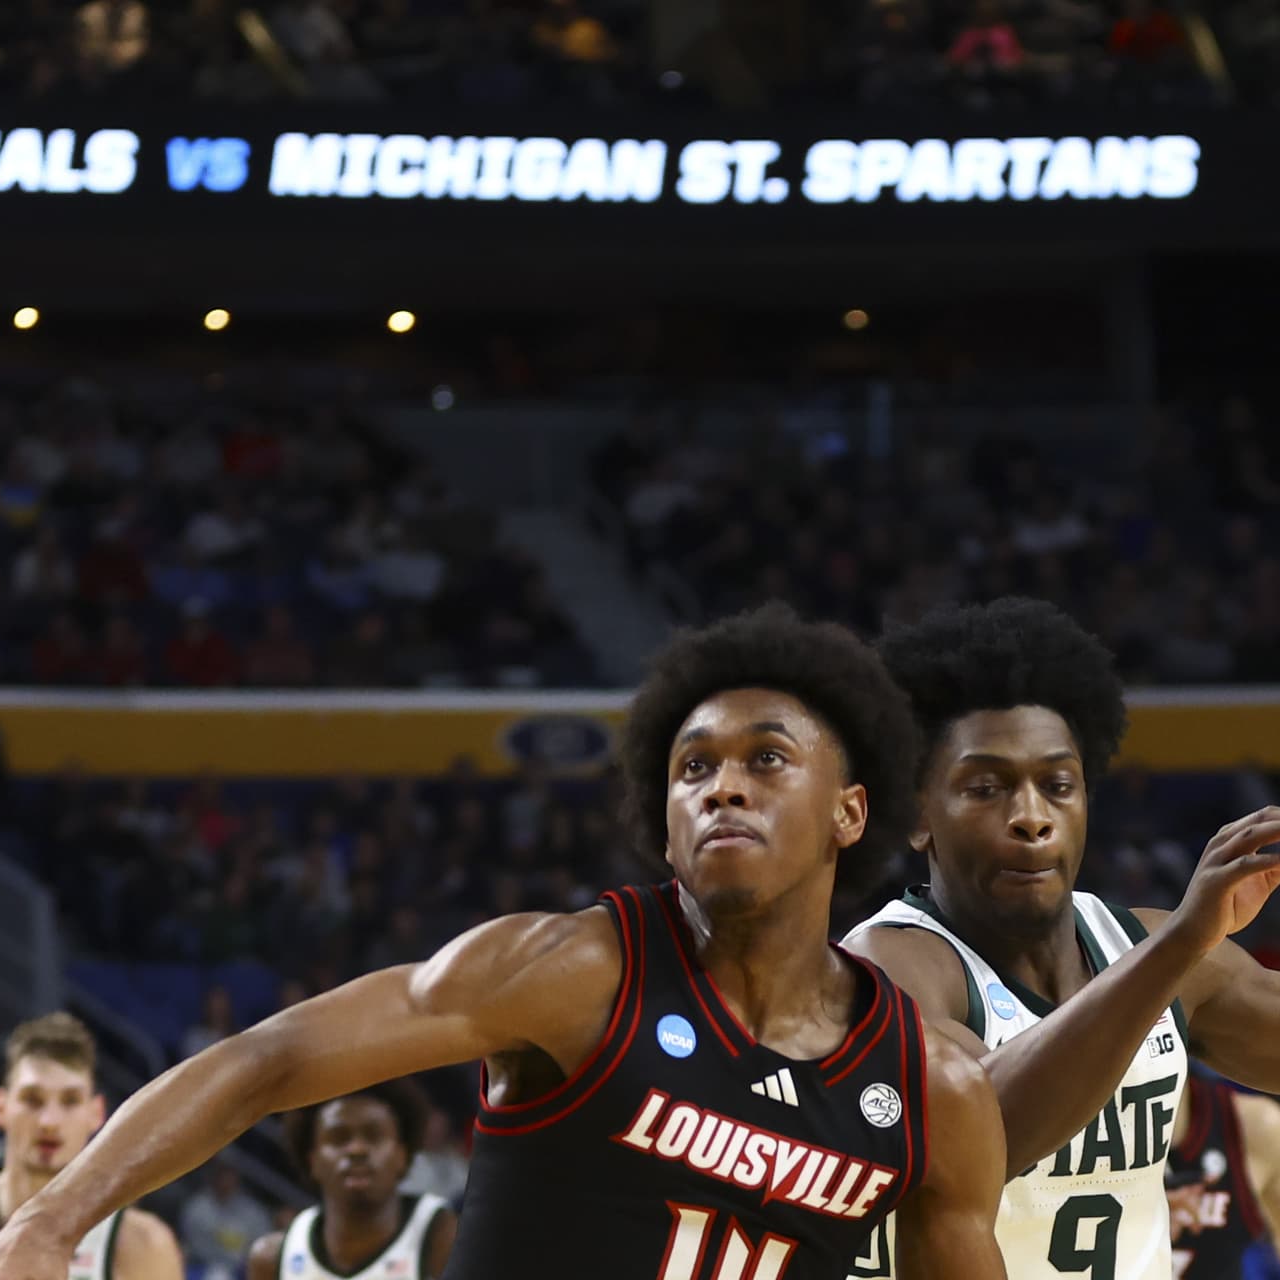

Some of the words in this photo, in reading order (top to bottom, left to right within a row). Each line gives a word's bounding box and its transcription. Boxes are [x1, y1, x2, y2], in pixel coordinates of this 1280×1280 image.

[166, 137, 250, 192] VS
[269, 133, 666, 202] MICHIGAN
[677, 140, 788, 203] ST.
[802, 136, 1200, 202] SPARTANS
[662, 1030, 693, 1049] NCAA
[613, 1089, 897, 1218] LOUISVILLE
[1019, 1073, 1178, 1178] ATE
